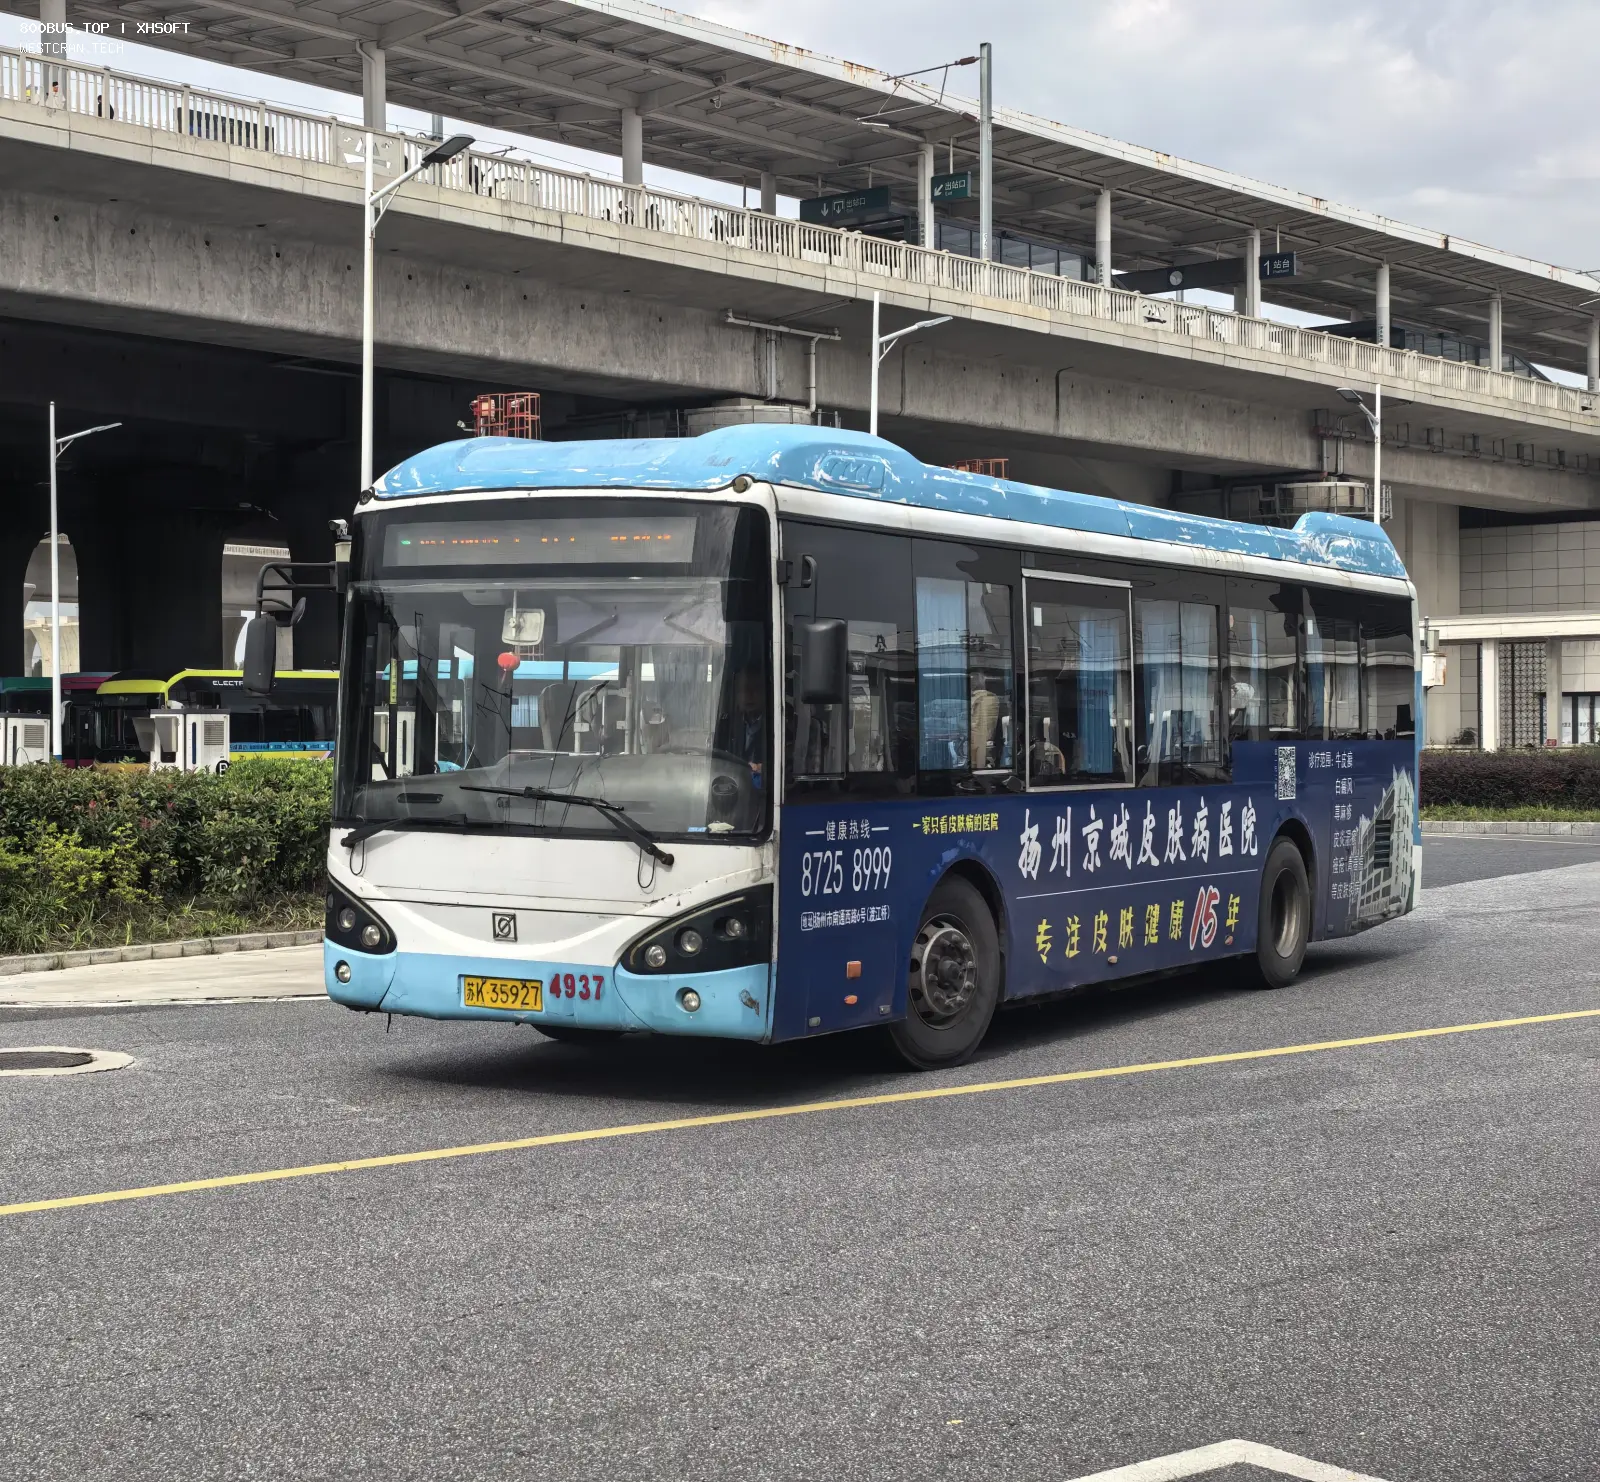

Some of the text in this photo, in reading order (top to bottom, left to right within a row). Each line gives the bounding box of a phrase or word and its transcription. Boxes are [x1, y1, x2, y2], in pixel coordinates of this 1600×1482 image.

[944, 179, 966, 191] 出站口
[846, 197, 866, 208] 出站口
[1263, 259, 1270, 276] 1
[1273, 258, 1290, 269] 站台
[825, 818, 871, 842] 健康热线
[912, 812, 999, 835] 一家只看皮肤病的医院
[1017, 796, 1258, 881] 扬州京城皮肤病医院
[801, 846, 892, 897] 8725 8999
[1035, 884, 1241, 965] 专注皮肤健康15年
[549, 972, 605, 1001] 4937
